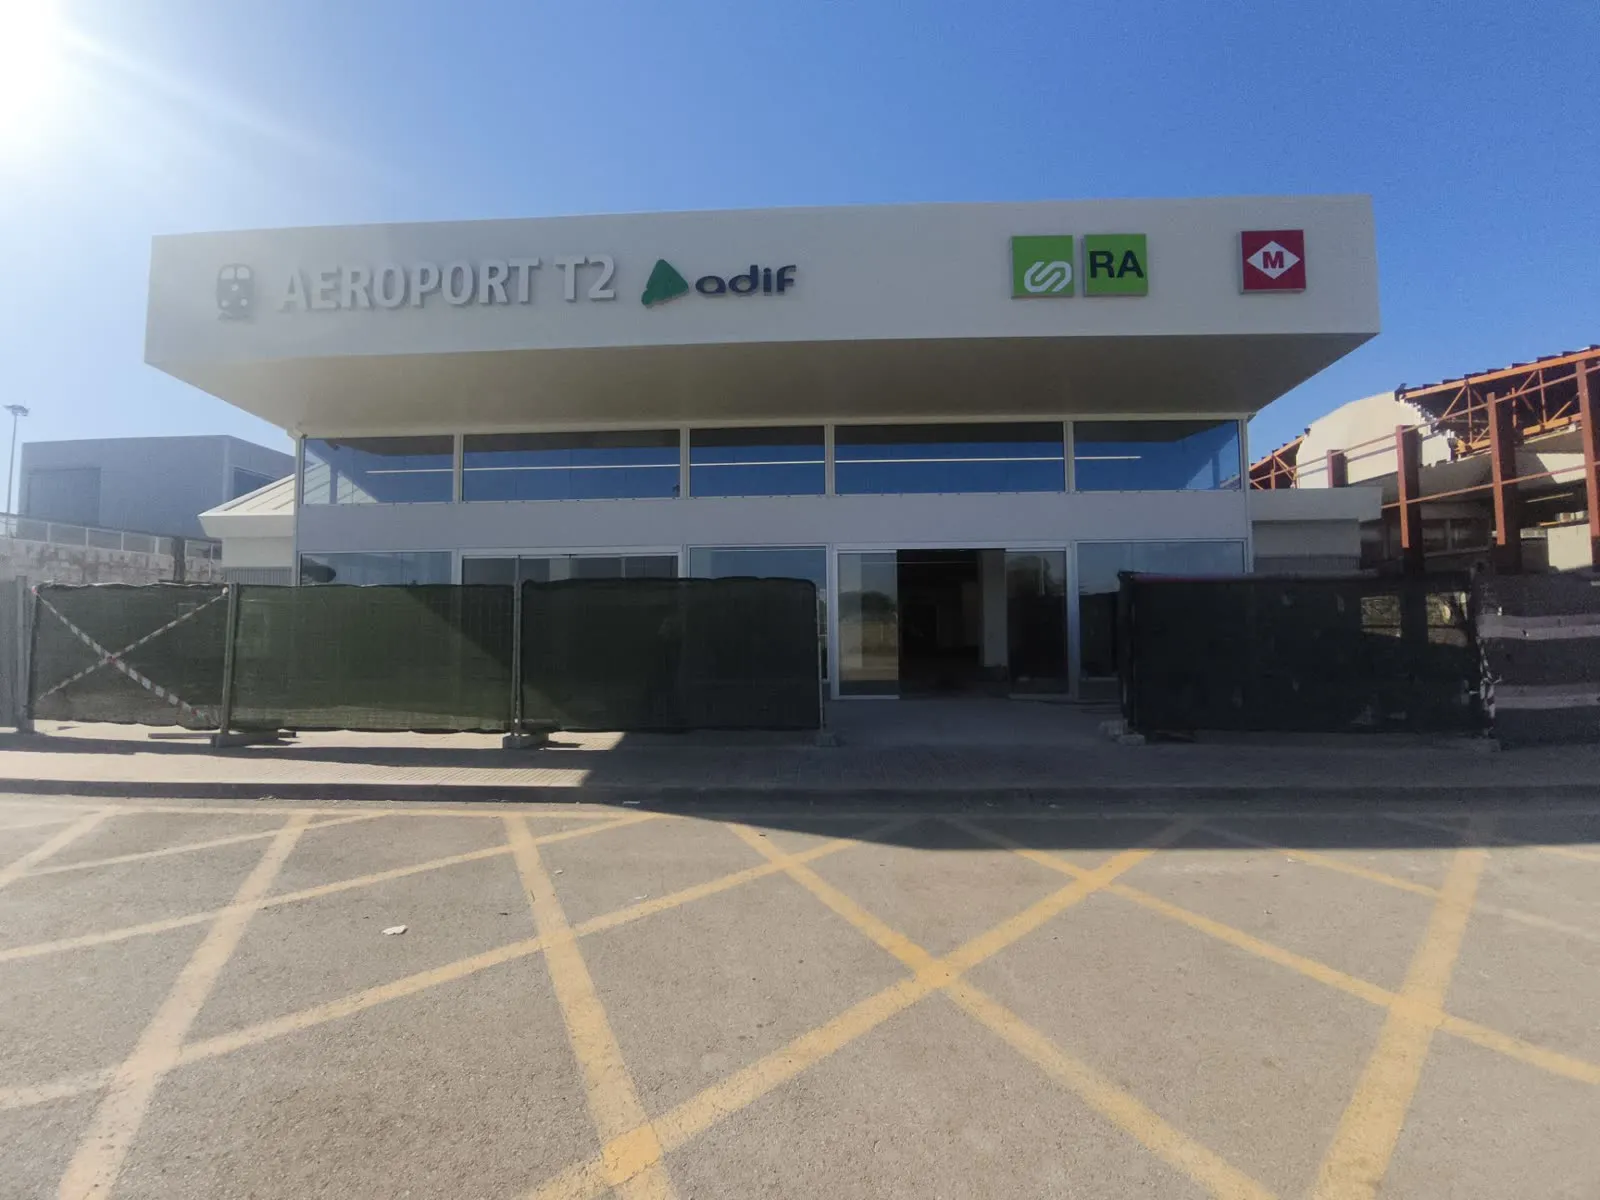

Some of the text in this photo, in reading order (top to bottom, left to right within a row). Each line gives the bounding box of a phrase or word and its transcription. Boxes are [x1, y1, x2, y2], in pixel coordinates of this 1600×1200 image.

[1089, 250, 1144, 279] RA
[1262, 251, 1284, 269] M
[280, 253, 616, 311] AEROPORT T2
[695, 264, 797, 296] adif
